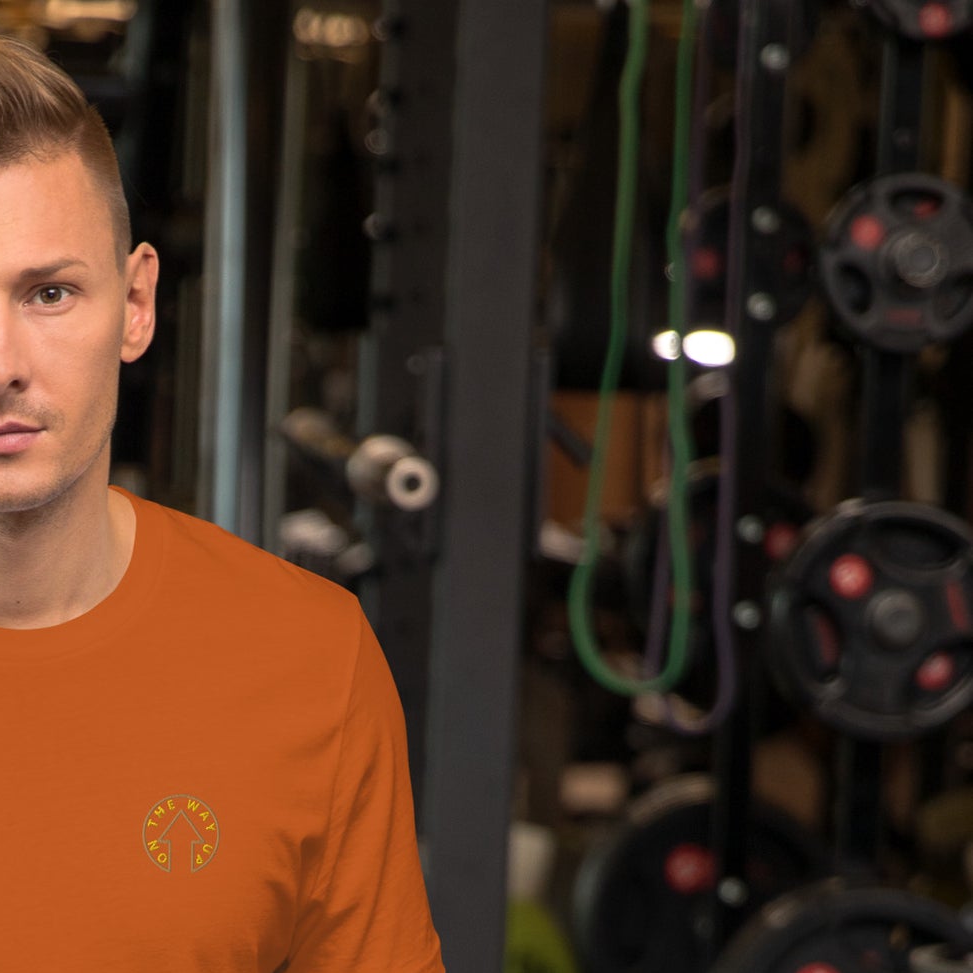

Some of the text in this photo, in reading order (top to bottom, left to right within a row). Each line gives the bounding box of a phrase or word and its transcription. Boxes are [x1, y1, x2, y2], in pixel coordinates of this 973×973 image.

[148, 799, 216, 864] ON THE WAY UP
